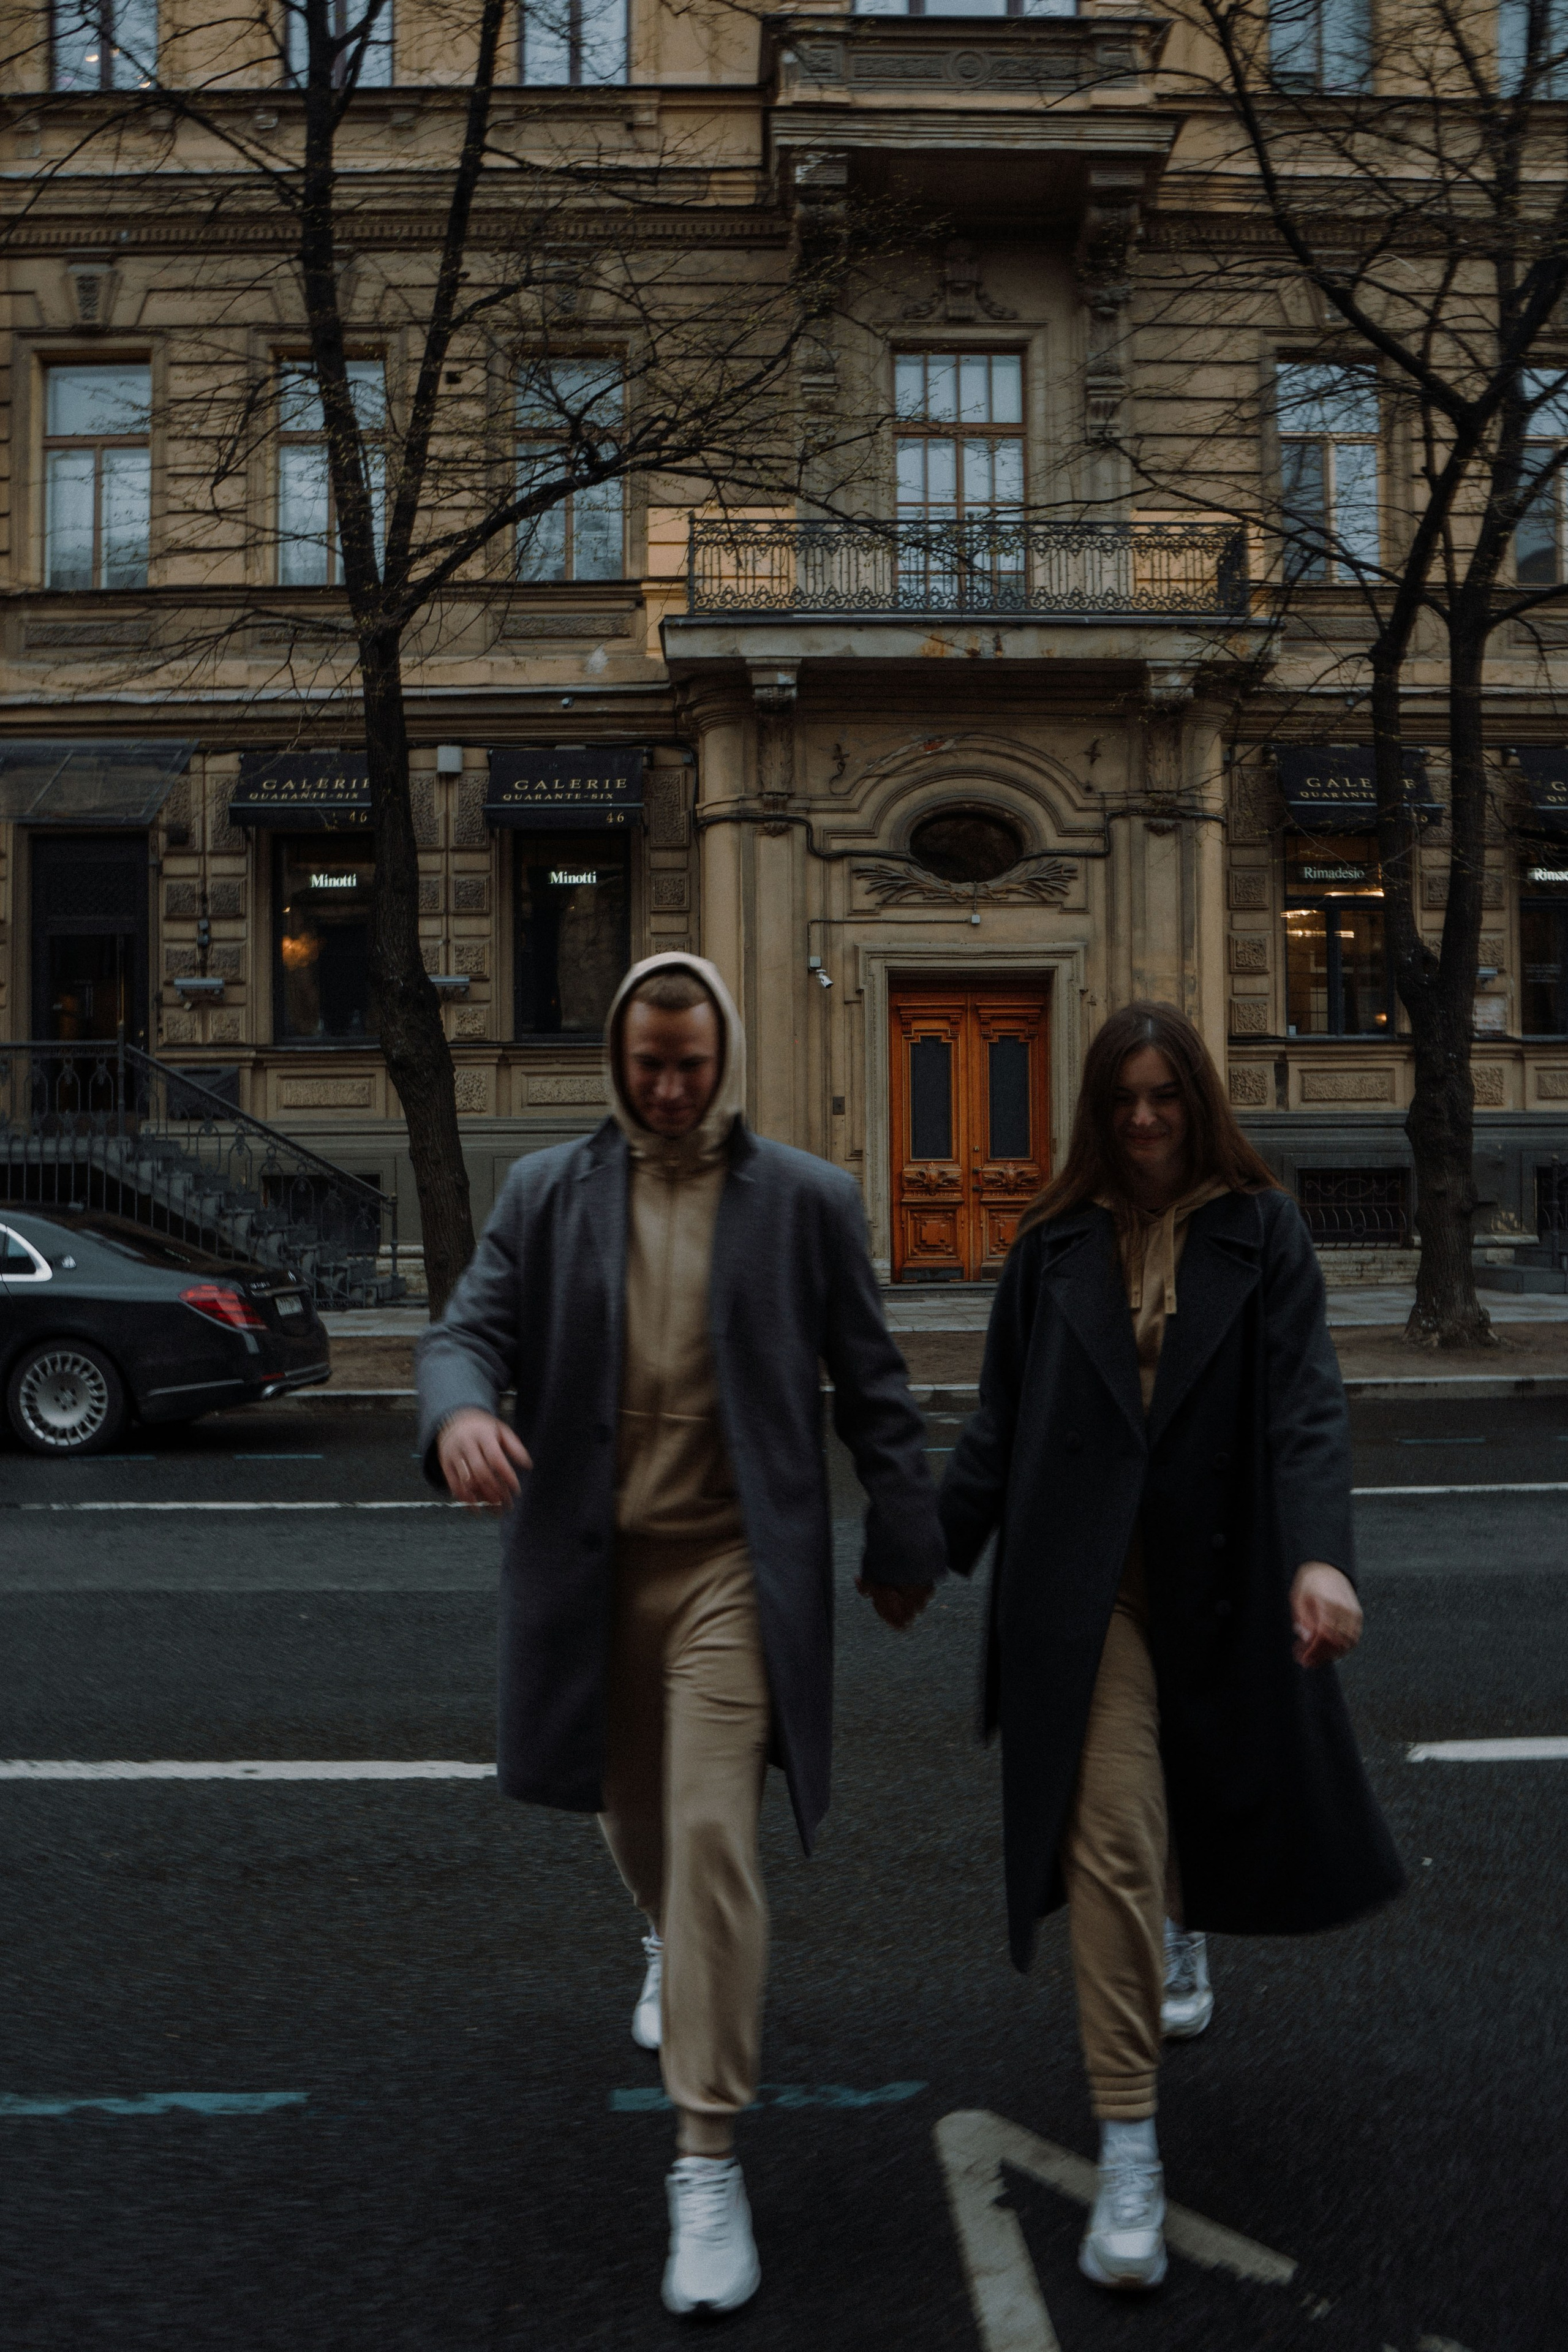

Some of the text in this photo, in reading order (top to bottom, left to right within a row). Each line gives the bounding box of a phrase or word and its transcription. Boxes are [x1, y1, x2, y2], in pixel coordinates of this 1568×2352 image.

[514, 778, 627, 791] GALERIE
[1305, 777, 1416, 790] GALEE
[349, 810, 368, 823] 46
[606, 812, 625, 824] 46
[550, 870, 597, 884] Minotti
[1303, 866, 1365, 880] Rimadesio
[311, 873, 357, 888] Minotti
